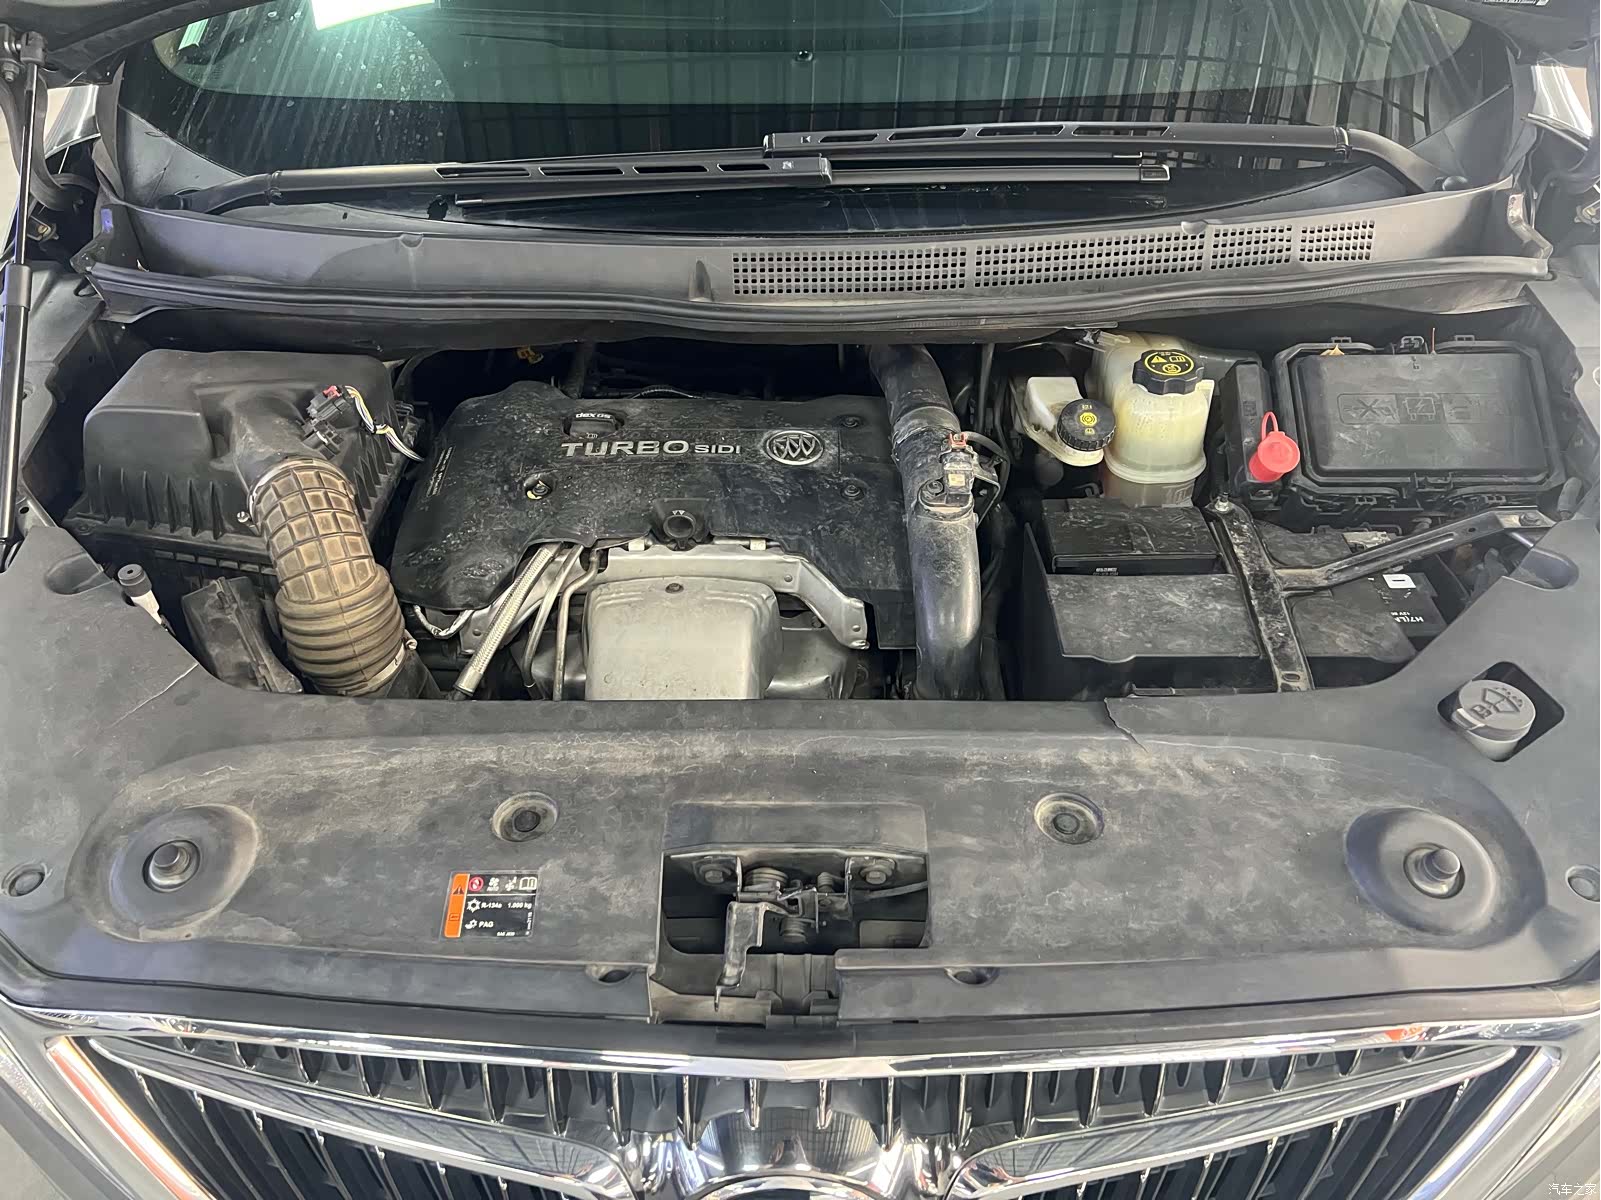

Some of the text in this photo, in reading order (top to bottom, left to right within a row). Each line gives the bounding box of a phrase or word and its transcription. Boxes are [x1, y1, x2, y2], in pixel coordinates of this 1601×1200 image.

[575, 412, 612, 420] dexos
[561, 440, 741, 457] TURBO SIDI
[523, 902, 533, 910] kg
[478, 920, 495, 928] PAG
